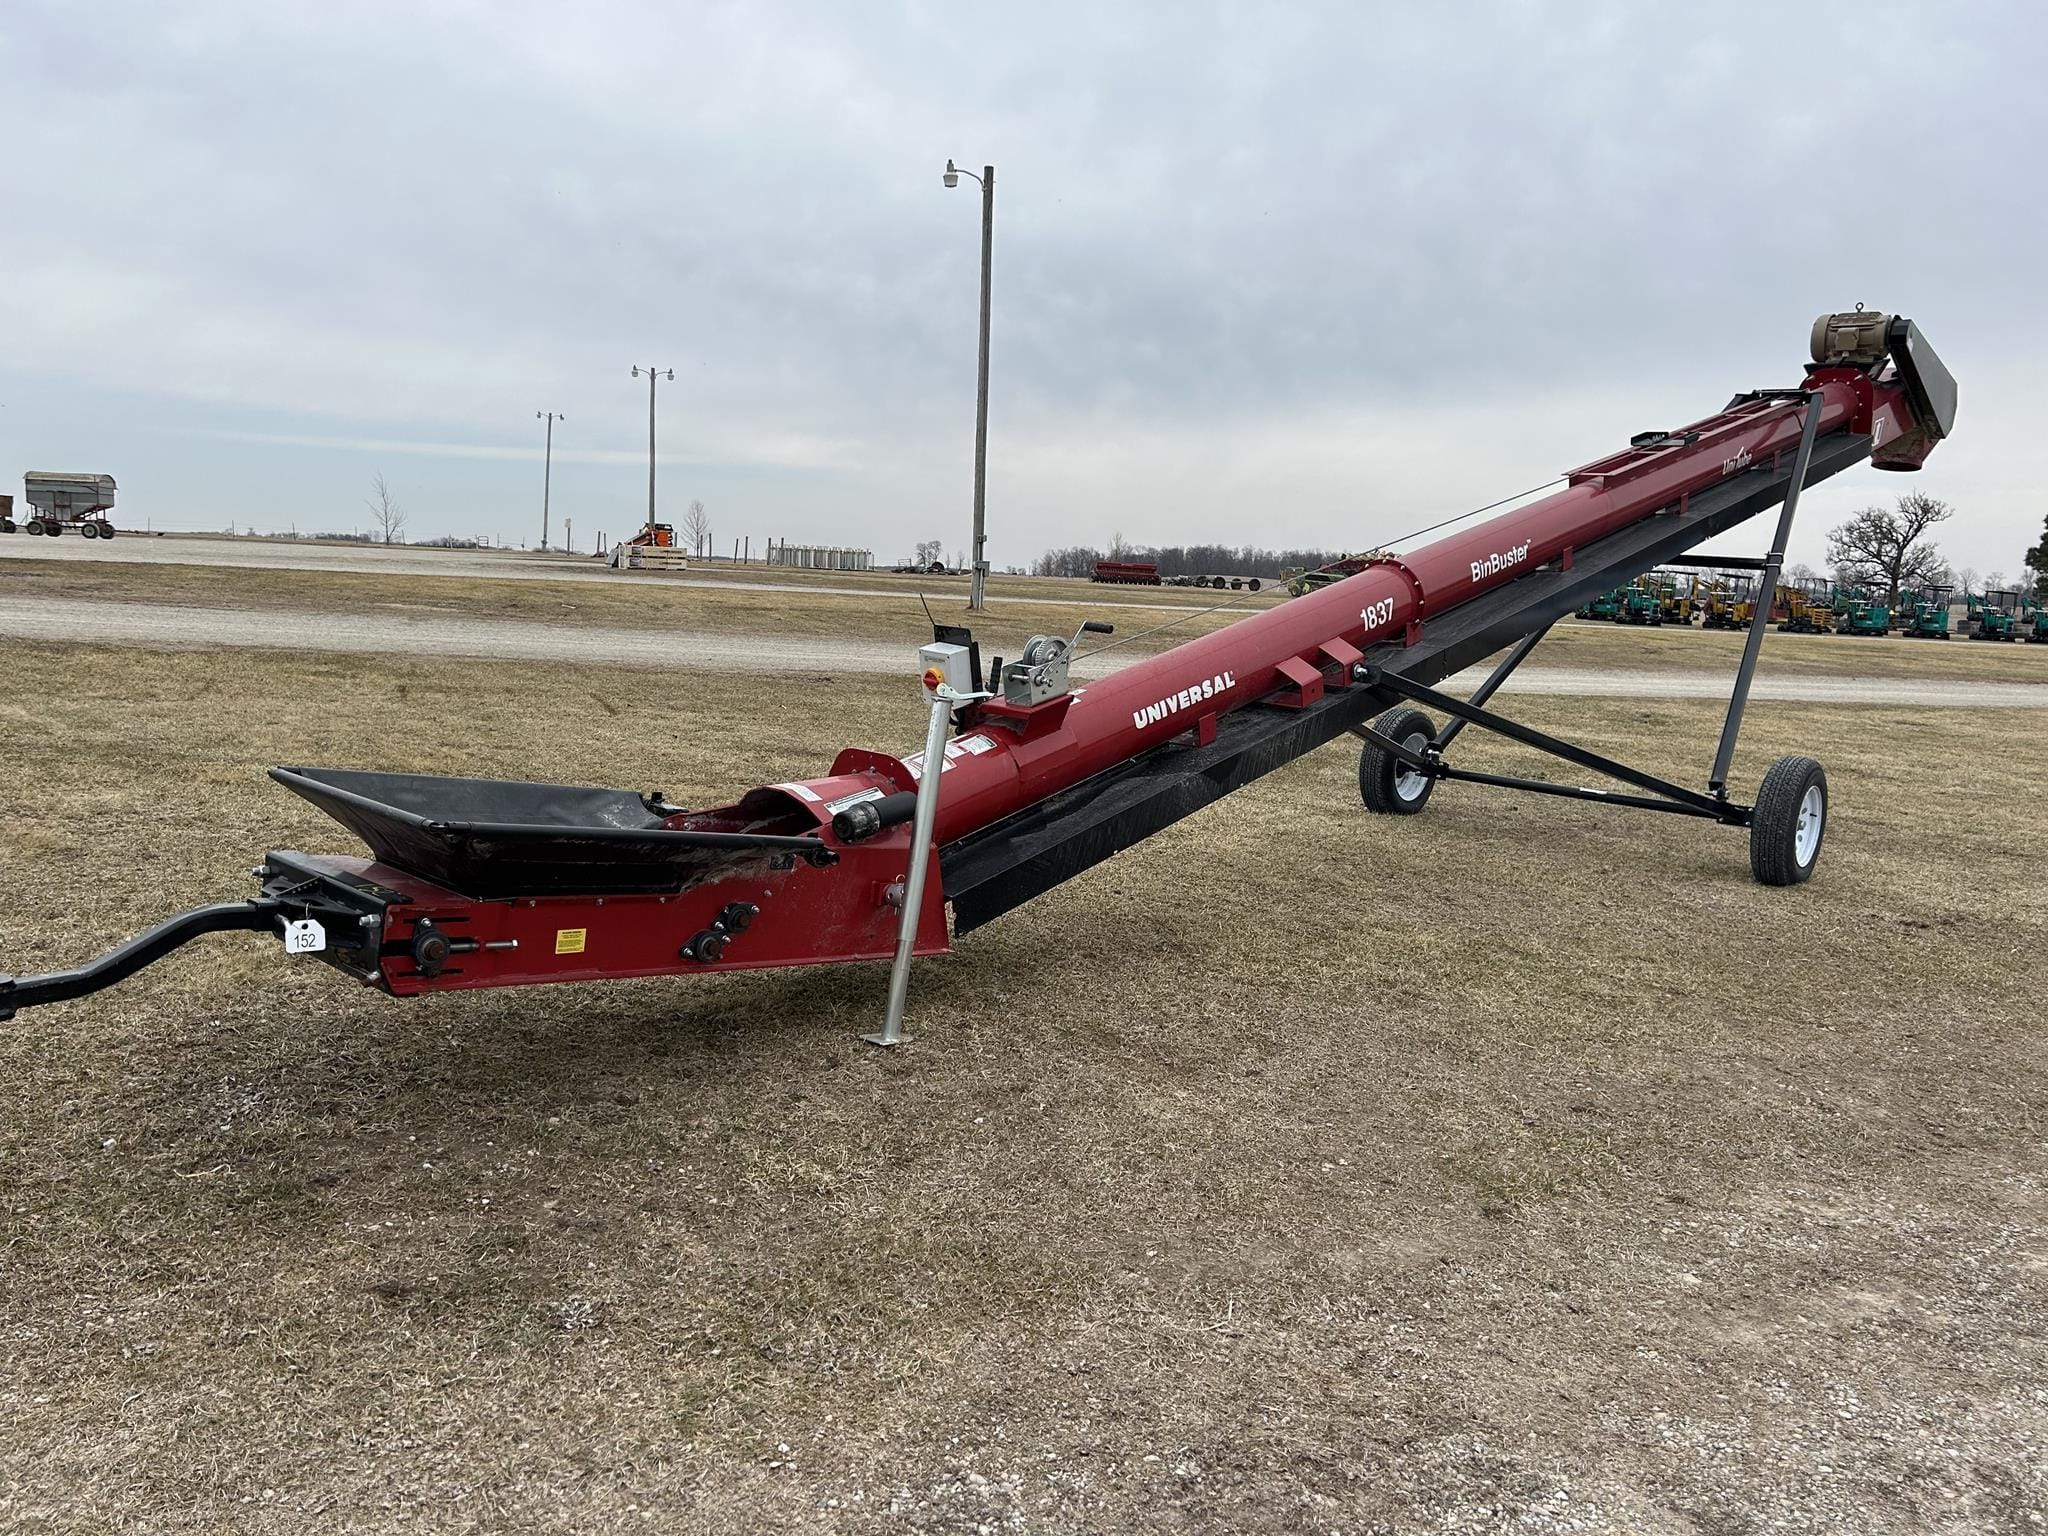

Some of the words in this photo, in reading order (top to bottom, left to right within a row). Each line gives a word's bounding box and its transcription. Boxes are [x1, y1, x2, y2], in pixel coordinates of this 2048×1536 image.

[1470, 543, 1530, 583] BinBuster
[1360, 597, 1394, 632] 1837
[1132, 671, 1236, 729] UNIVERSAL
[294, 933, 316, 949] 152
